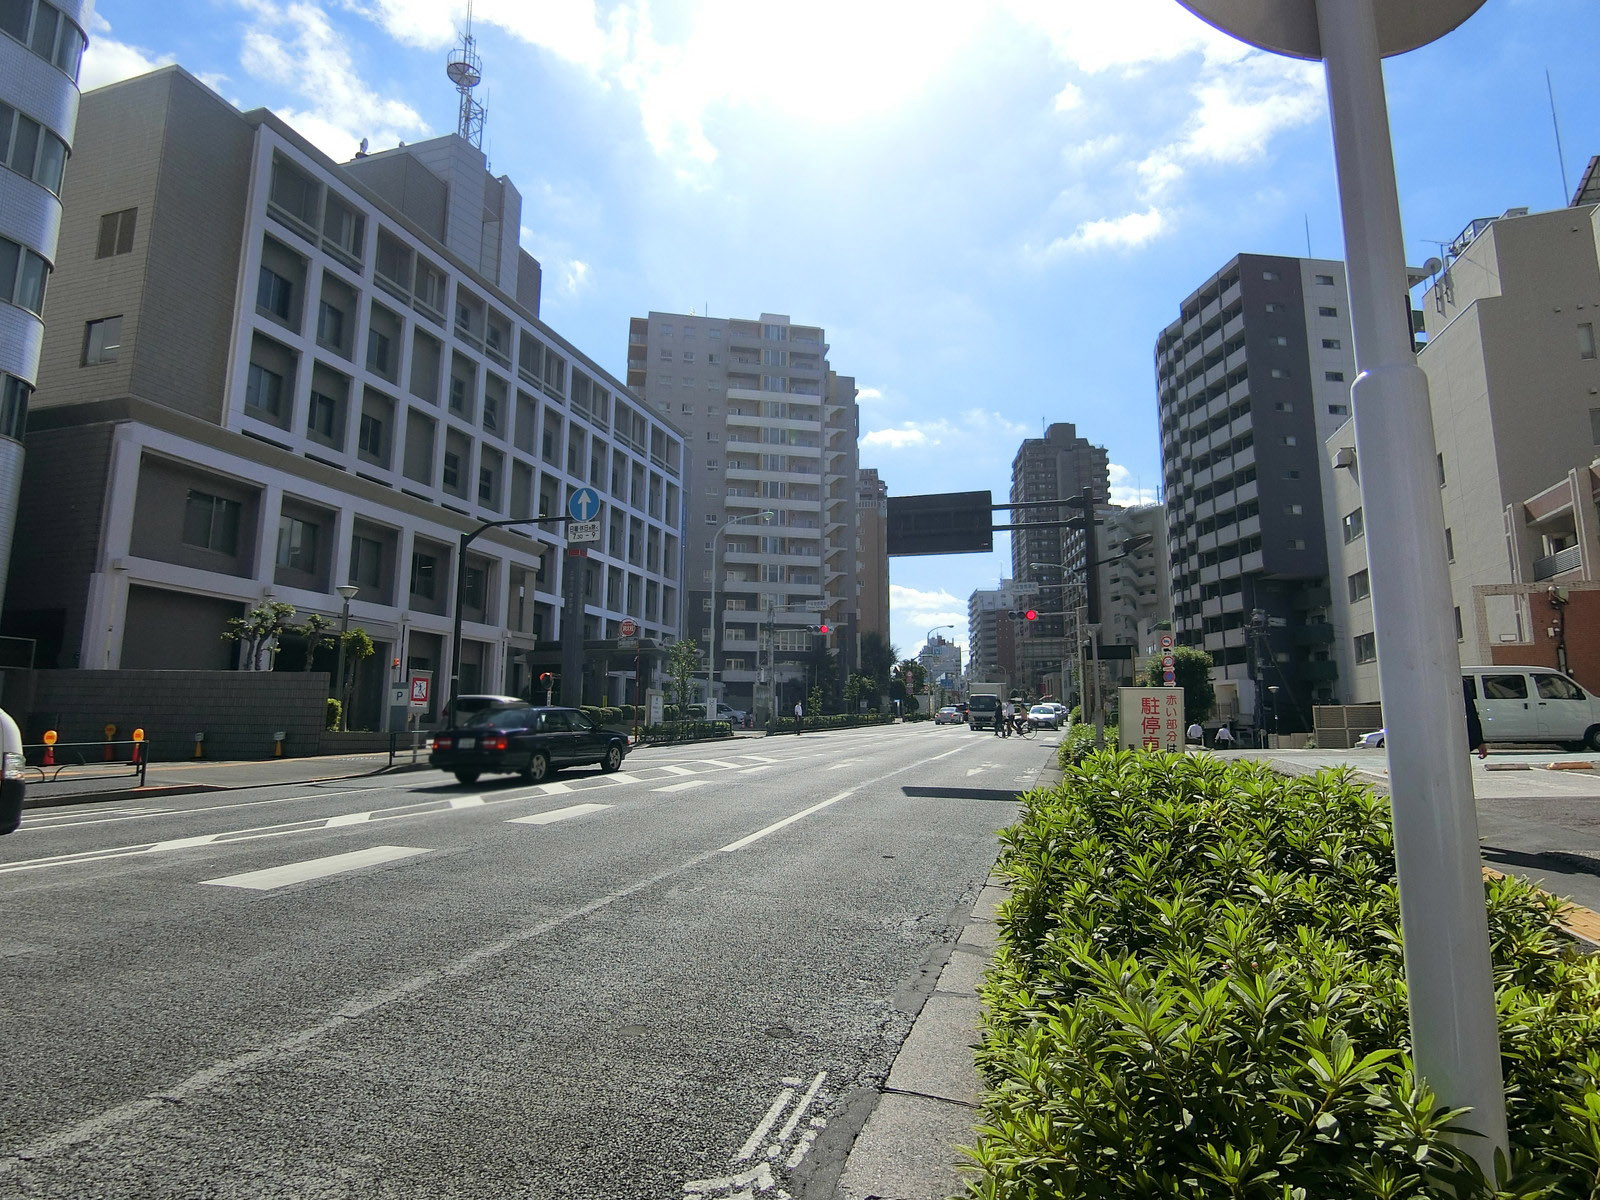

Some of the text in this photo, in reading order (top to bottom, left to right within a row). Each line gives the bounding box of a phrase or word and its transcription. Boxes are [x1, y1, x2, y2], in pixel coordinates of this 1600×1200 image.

[396, 691, 404, 701] P
[1165, 695, 1177, 754] 赤い部分は
